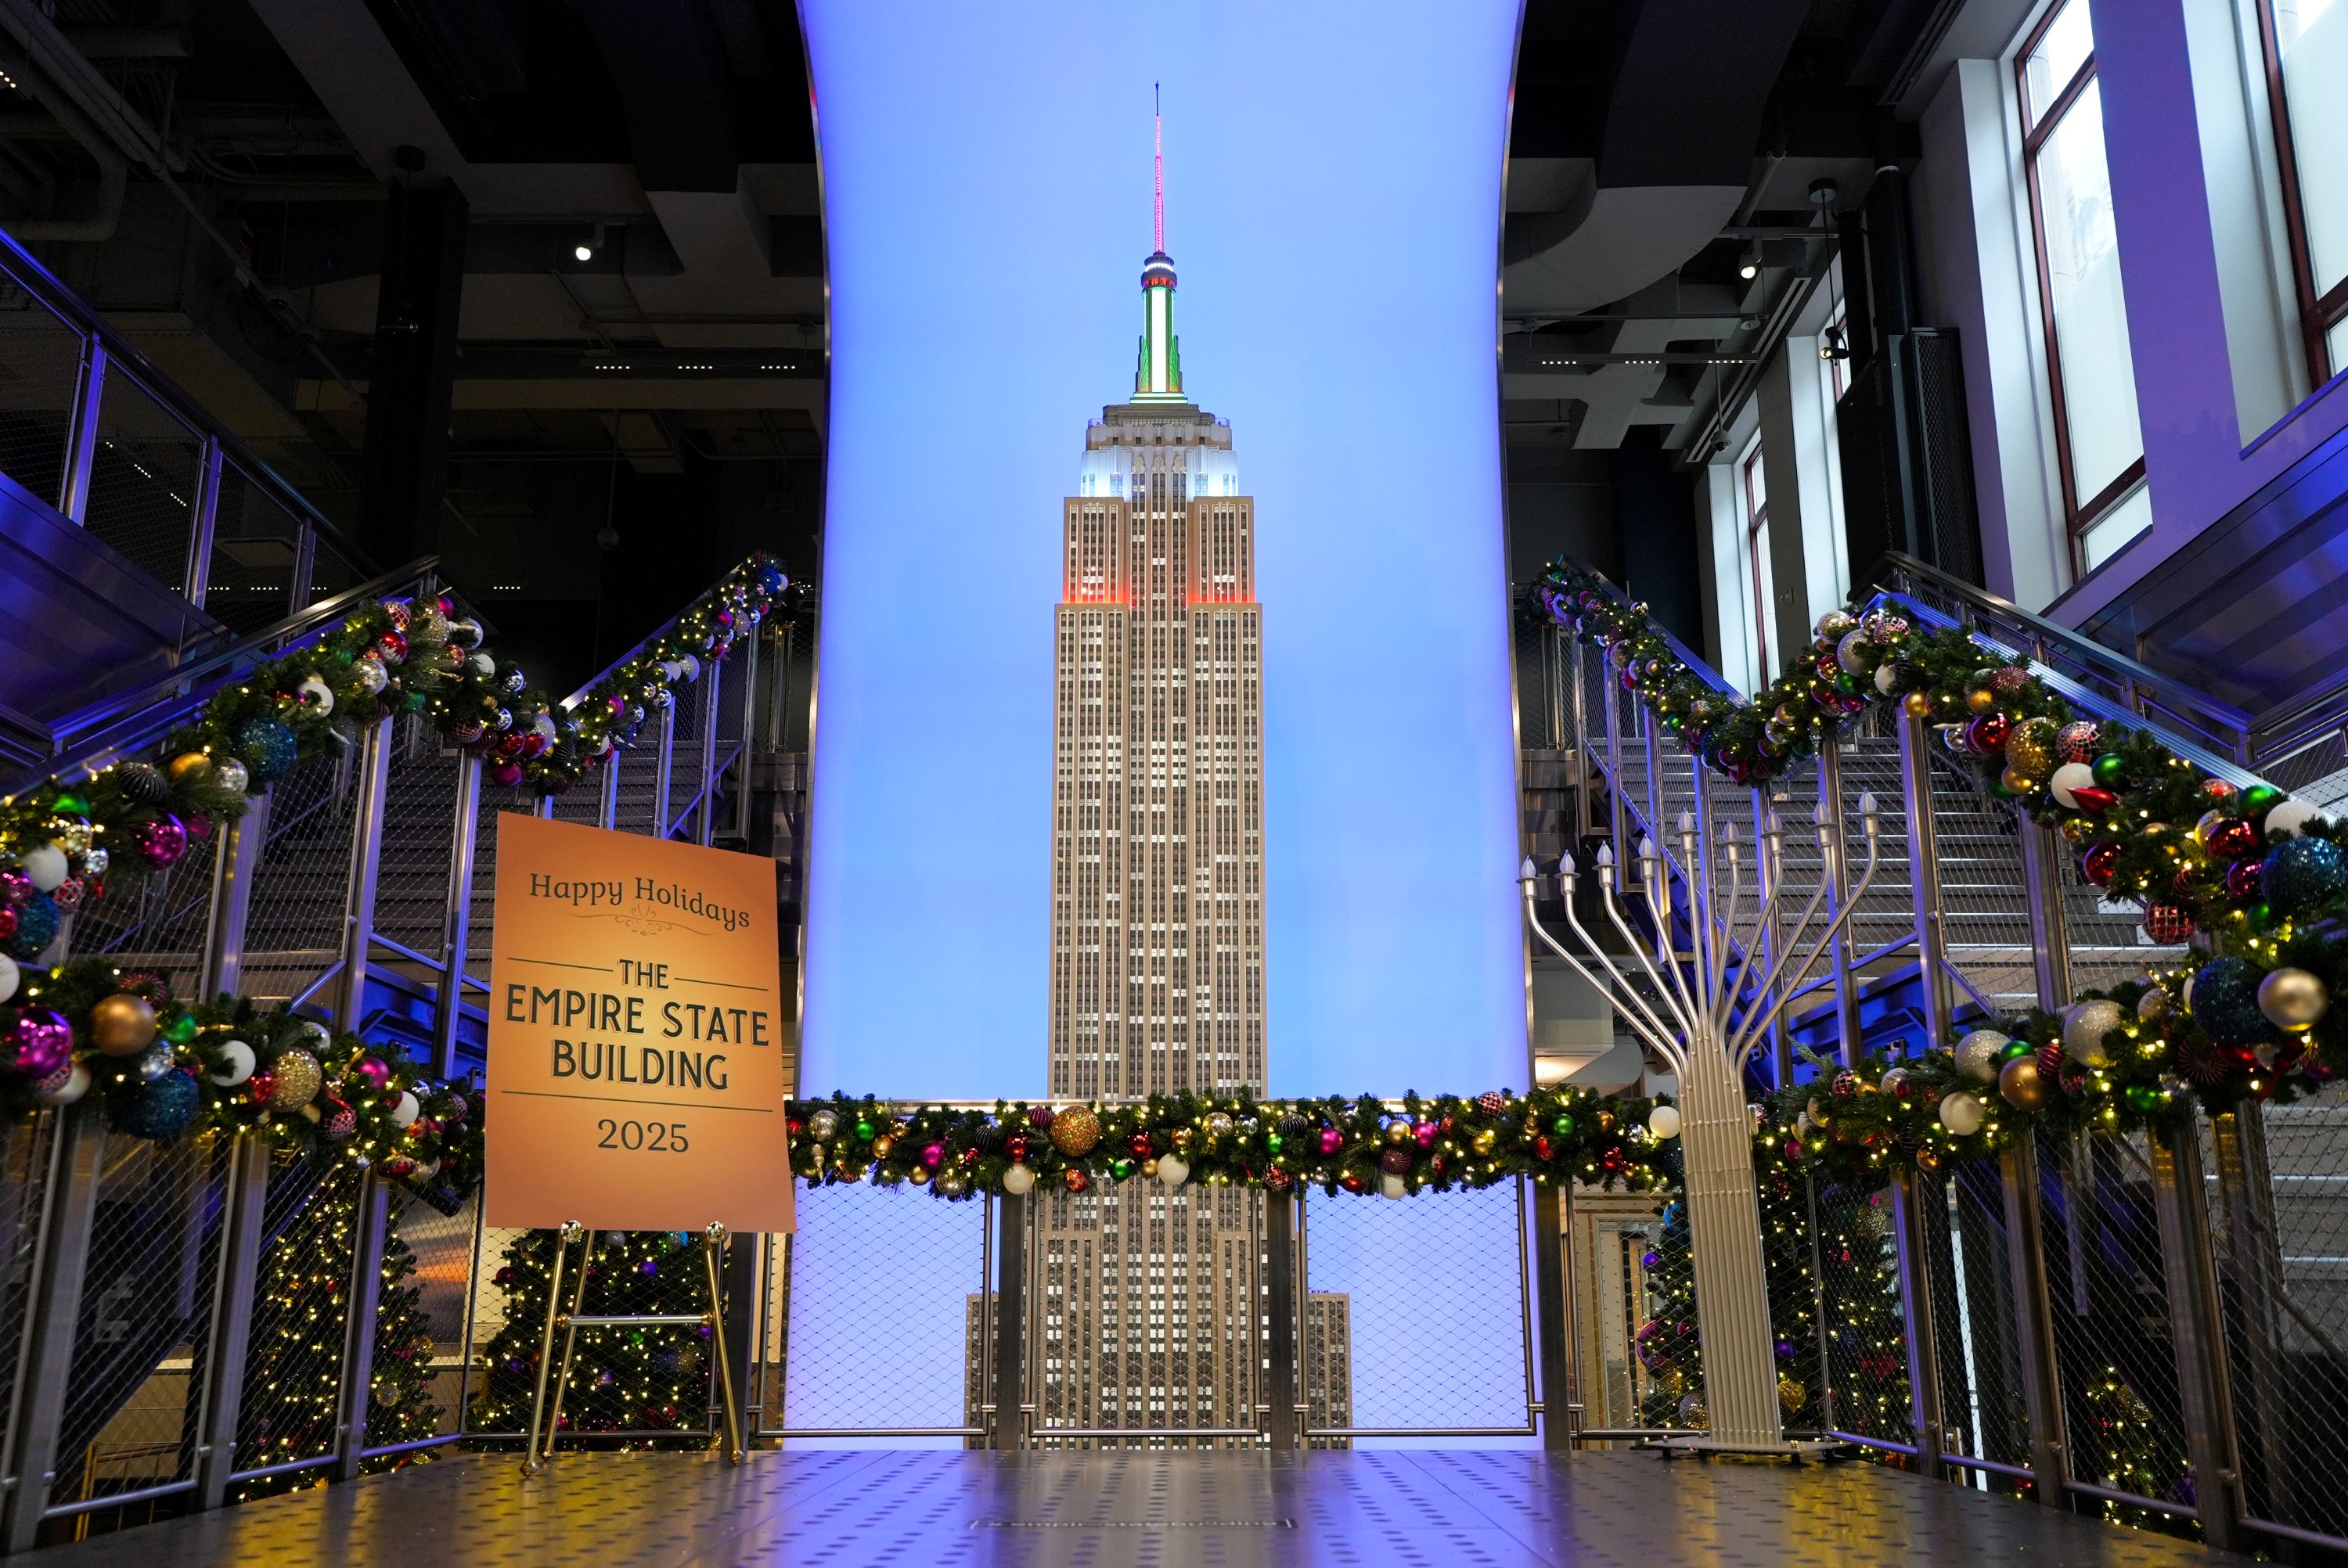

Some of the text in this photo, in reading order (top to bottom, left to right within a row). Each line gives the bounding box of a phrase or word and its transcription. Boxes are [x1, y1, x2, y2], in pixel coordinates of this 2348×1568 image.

[529, 872, 751, 932] Happy Holidays
[618, 958, 670, 990] THE
[505, 983, 769, 1048] EMPIRE STATE
[551, 1039, 729, 1091] BUILDING
[597, 1119, 689, 1153] 2025
